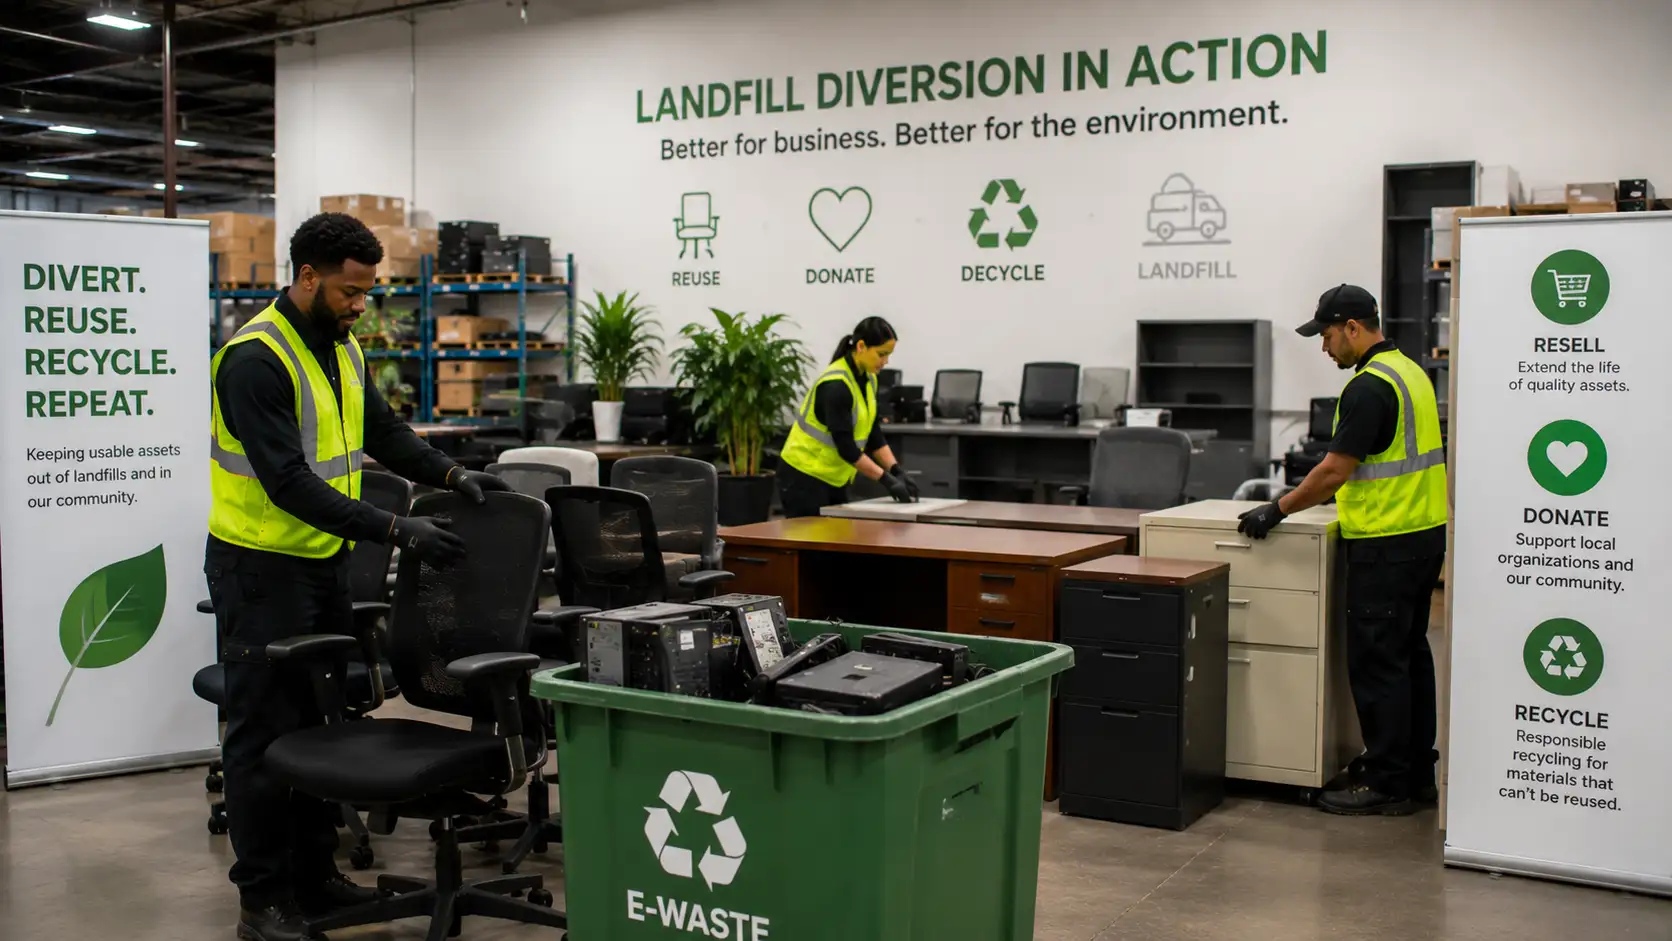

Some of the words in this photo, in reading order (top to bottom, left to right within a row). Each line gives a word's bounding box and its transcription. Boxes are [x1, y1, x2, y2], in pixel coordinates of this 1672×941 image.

[637, 76, 804, 123] LANDFILL
[818, 54, 1044, 109] DIVERSION
[1063, 49, 1108, 91] IN
[1125, 30, 1326, 87] ACTION
[662, 138, 728, 160] Better
[735, 133, 767, 155] for
[775, 128, 885, 153] business.
[896, 122, 976, 146] Better
[984, 116, 1023, 140] for
[1031, 113, 1076, 137] the
[1086, 101, 1287, 134] environment.
[24, 264, 145, 293] DIVERT.
[672, 271, 720, 286] REUSE
[806, 268, 874, 284] DONATE
[962, 265, 1044, 281] DECYCLE
[1138, 261, 1237, 279] LANDFILL
[25, 306, 136, 334] REUSE.
[1535, 338, 1605, 352] RESELL
[26, 349, 176, 375] RECYCLE.
[1519, 361, 1566, 373] Extend
[1571, 361, 1594, 373] the
[1599, 361, 1620, 373] life
[1509, 378, 1523, 390] of
[1527, 379, 1575, 394] quality
[1580, 380, 1629, 391] assets.
[26, 390, 153, 417] REPEAT.
[27, 447, 84, 463] Keeping
[89, 445, 134, 458] usable
[138, 444, 180, 456] assets
[28, 472, 51, 484] out
[55, 470, 69, 483] of
[74, 468, 126, 482] landfills
[131, 467, 155, 480] and
[160, 466, 171, 478] in
[28, 498, 52, 508] our
[56, 491, 137, 506] community.
[1524, 508, 1608, 526] DONATE
[1516, 533, 1576, 549] Support
[1581, 536, 1615, 550] local
[1498, 554, 1599, 569] organizations
[1605, 559, 1633, 571] and
[1507, 575, 1531, 584] our
[1536, 577, 1624, 594] community.
[1516, 705, 1608, 729] RECYCLE
[1517, 730, 1606, 751] Responsible
[1513, 751, 1582, 770] recycling
[1587, 756, 1608, 770] for
[1507, 768, 1578, 787] materials
[1582, 776, 1613, 790] that
[1541, 789, 1559, 803] be
[1564, 795, 1621, 810] reused.
[627, 889, 770, 941] E-WASTE
